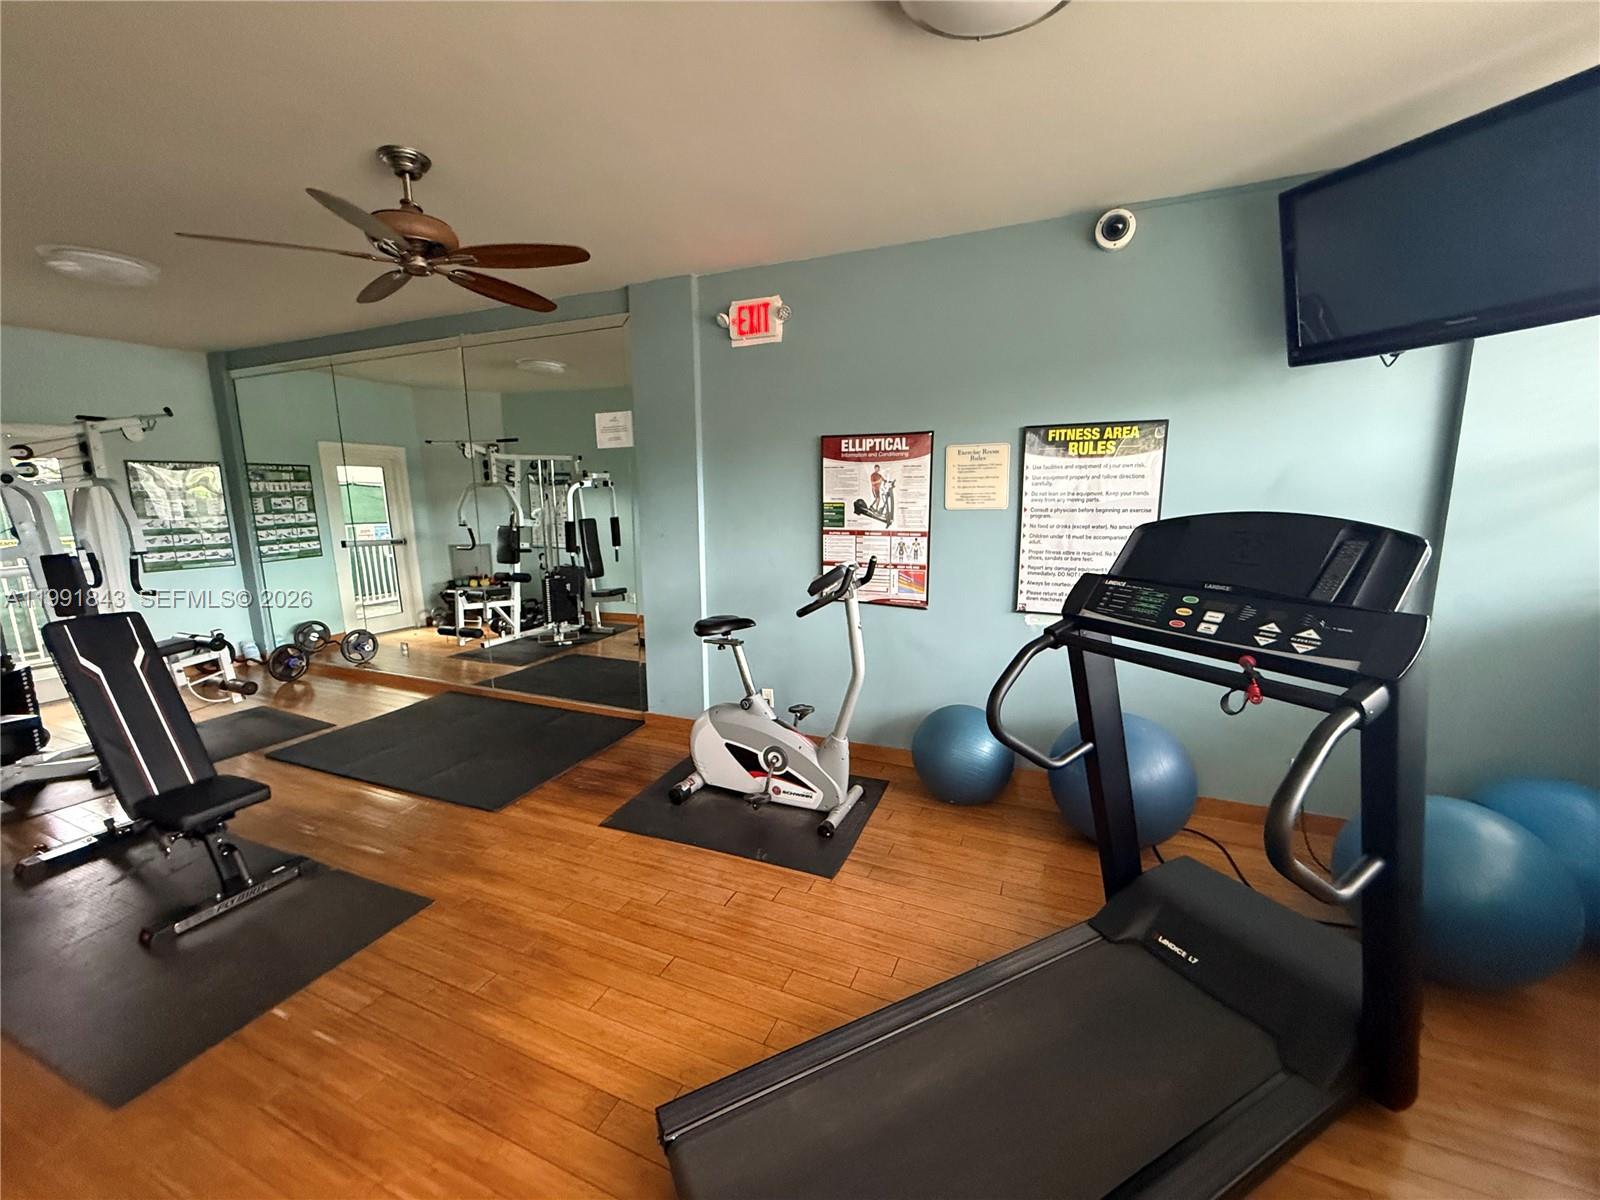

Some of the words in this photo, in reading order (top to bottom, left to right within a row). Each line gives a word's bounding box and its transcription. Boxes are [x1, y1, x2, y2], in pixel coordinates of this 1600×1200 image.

[737, 302, 770, 336] EXIT
[1048, 428, 1100, 442] FITNESS
[1103, 425, 1140, 440] AREA
[841, 438, 909, 452] ELLIPTICAL
[1068, 440, 1117, 455] RULES
